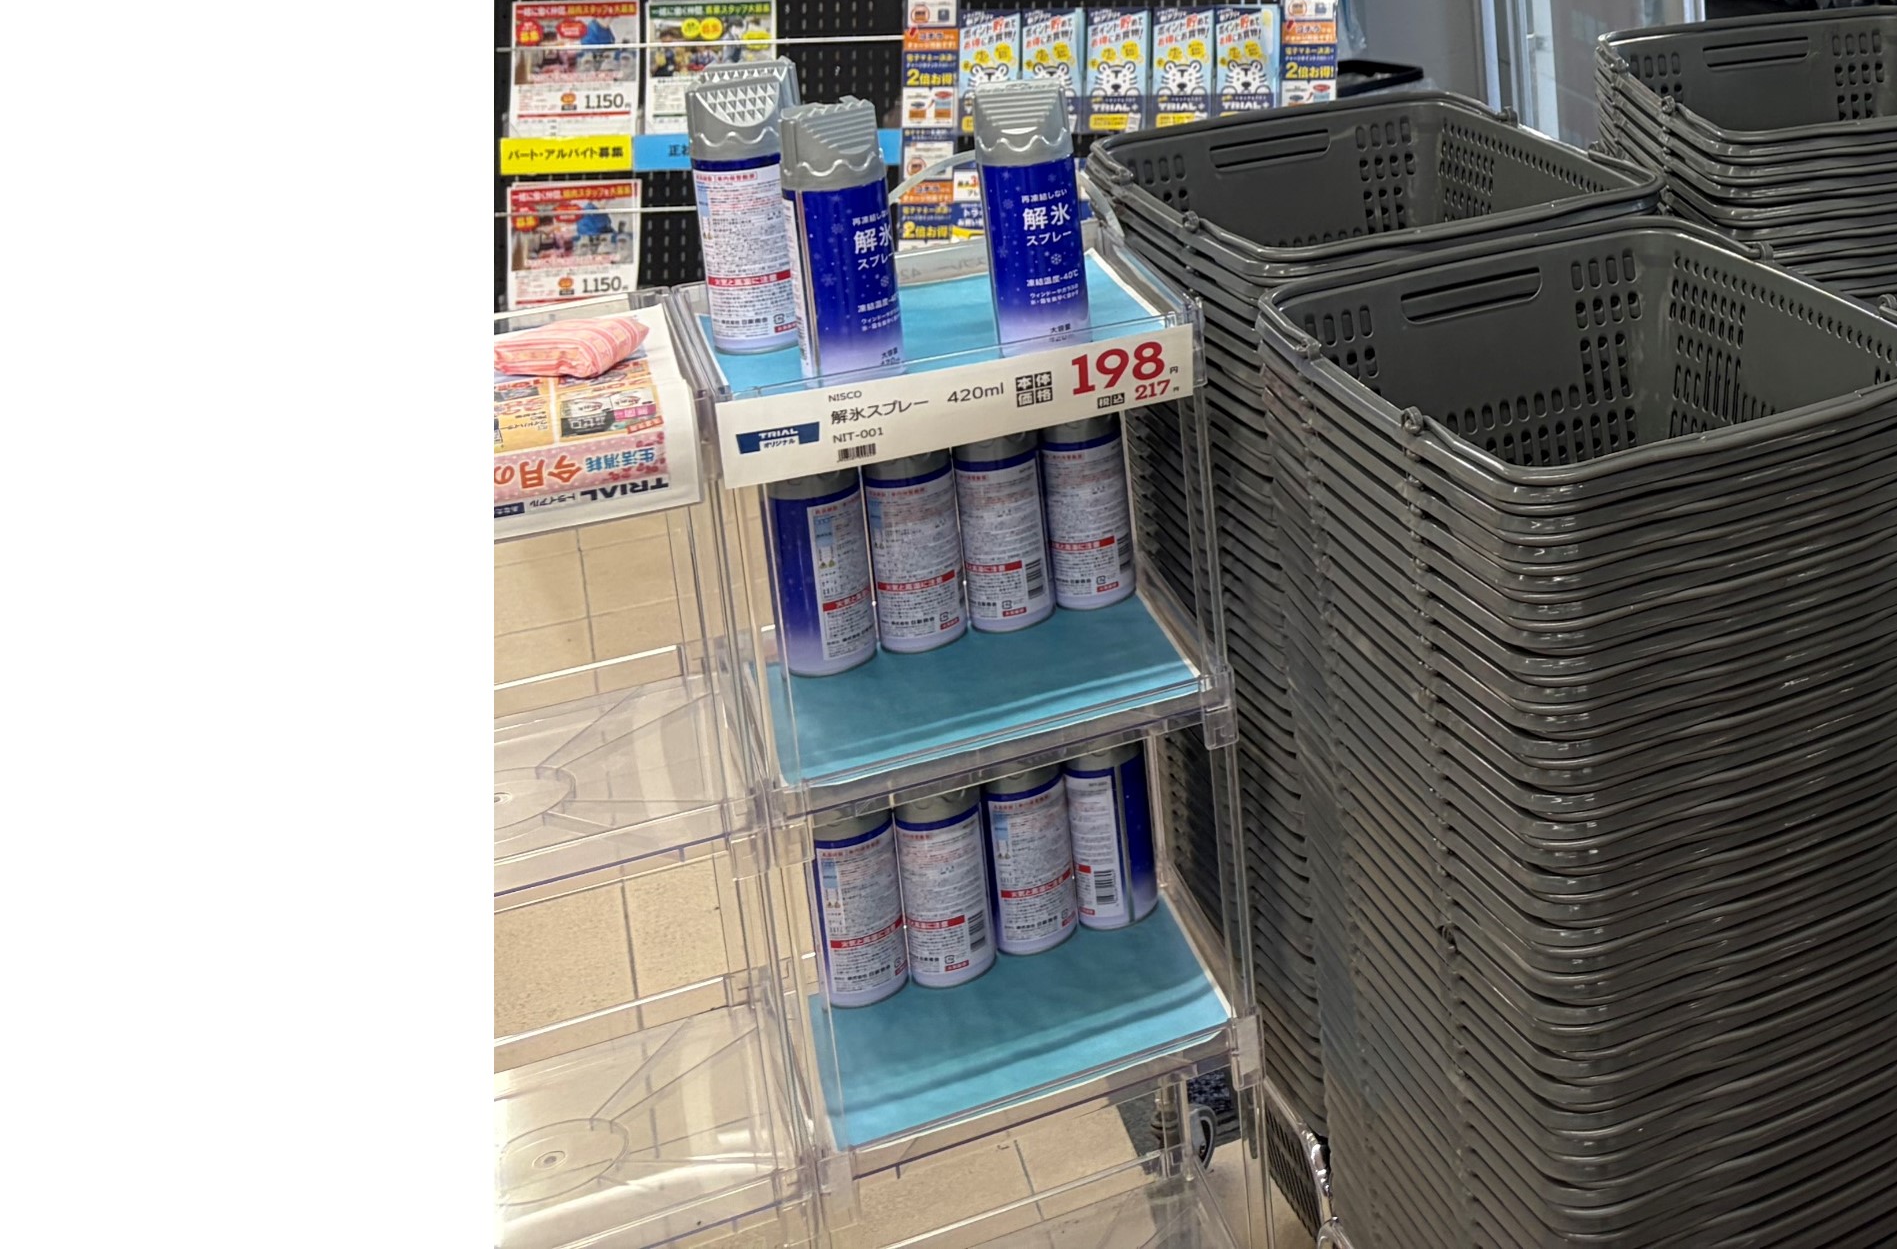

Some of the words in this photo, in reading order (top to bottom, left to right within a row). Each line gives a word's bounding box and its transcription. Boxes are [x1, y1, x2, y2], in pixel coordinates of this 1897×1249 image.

[584, 94, 624, 110] 1,150
[508, 148, 624, 161] パート・アルバイト募集
[1021, 189, 1067, 203] 再凍結しない
[1023, 203, 1070, 231] 解氷
[853, 224, 892, 255] 解氷
[1026, 231, 1072, 247] スプレー
[857, 253, 895, 270] スプレー
[581, 277, 621, 293] 1,150
[1071, 341, 1166, 396] 198
[828, 390, 862, 403] NISCO
[1098, 393, 1125, 409] 税込
[1135, 379, 1171, 401] 217
[831, 400, 929, 426] 解氷スプレー
[947, 383, 1004, 405] 420ml
[758, 427, 799, 439] TRIAL
[833, 427, 884, 445] NIT-001
[764, 438, 796, 449] オリジナル
[581, 477, 669, 501] TRIAL
